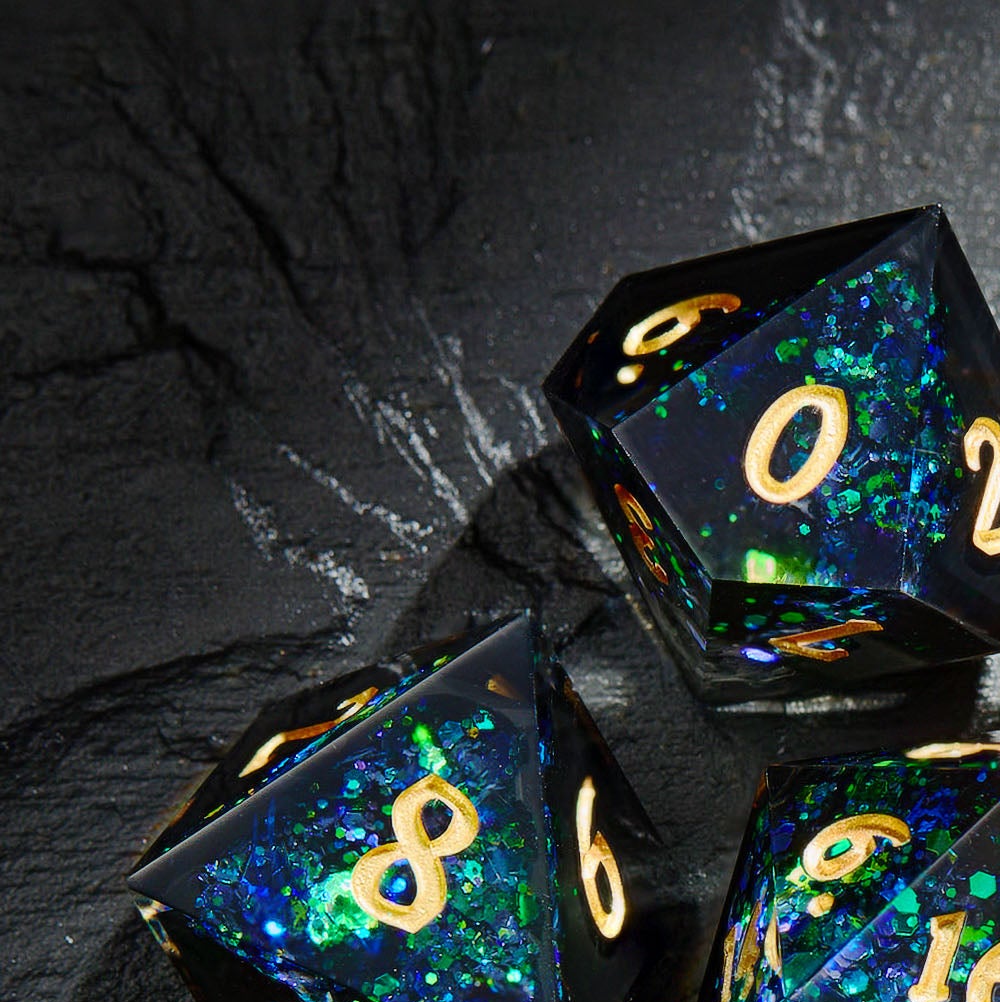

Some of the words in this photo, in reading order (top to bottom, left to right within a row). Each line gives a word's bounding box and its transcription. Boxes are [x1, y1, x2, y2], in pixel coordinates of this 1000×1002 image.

[744, 384, 848, 504] 0
[351, 773, 481, 934] 8
[575, 776, 626, 939] 6
